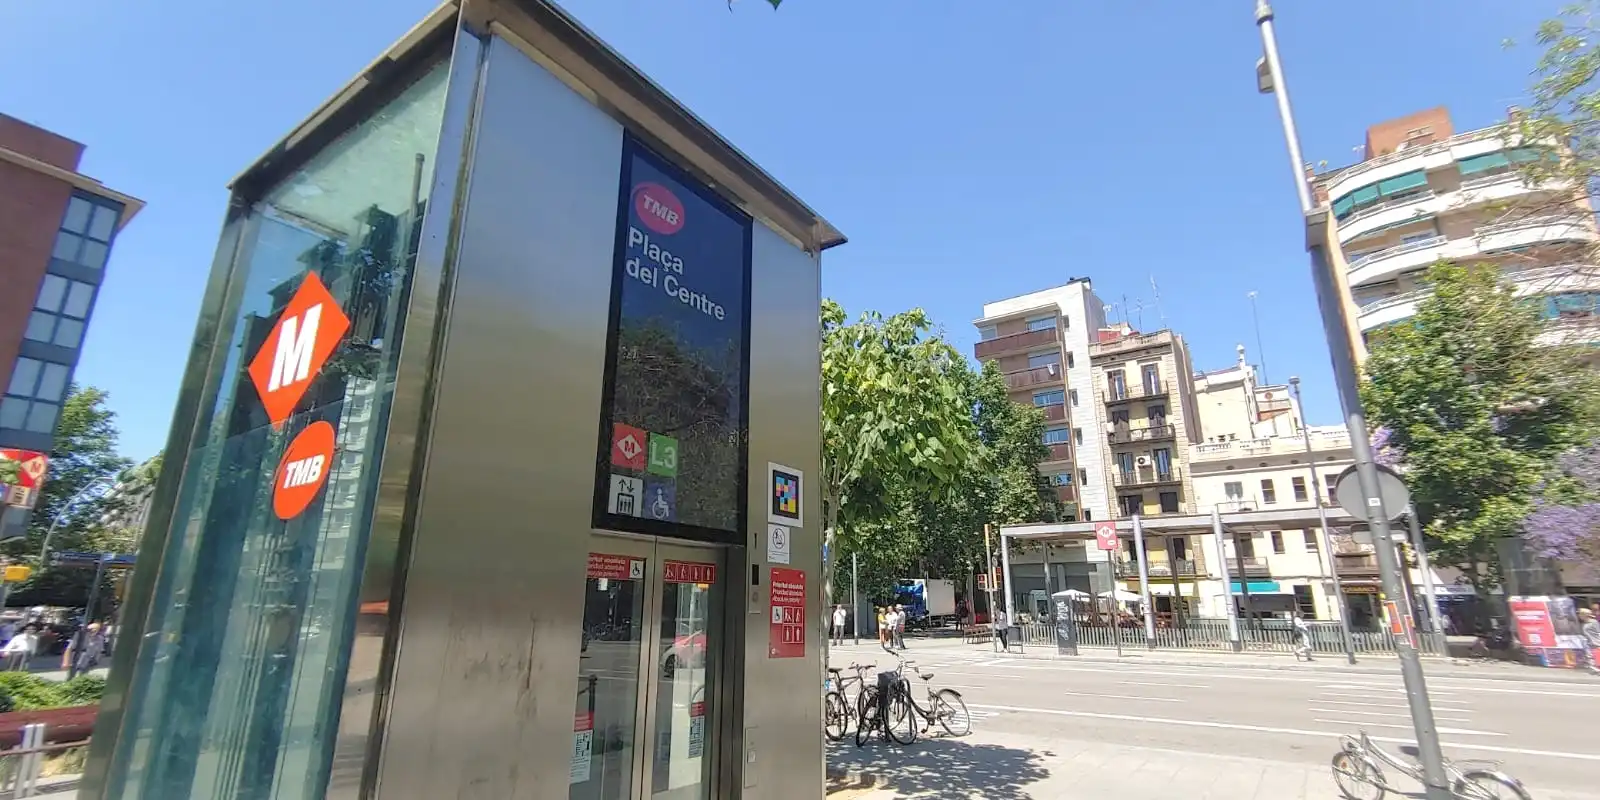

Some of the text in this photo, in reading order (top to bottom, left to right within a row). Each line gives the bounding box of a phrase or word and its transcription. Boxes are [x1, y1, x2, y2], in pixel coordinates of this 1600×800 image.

[643, 195, 680, 226] TMB
[628, 226, 683, 275] Plaça
[626, 258, 726, 321] del Centre
[267, 303, 323, 393] M
[283, 454, 325, 489] TMB
[652, 441, 676, 468] L3
